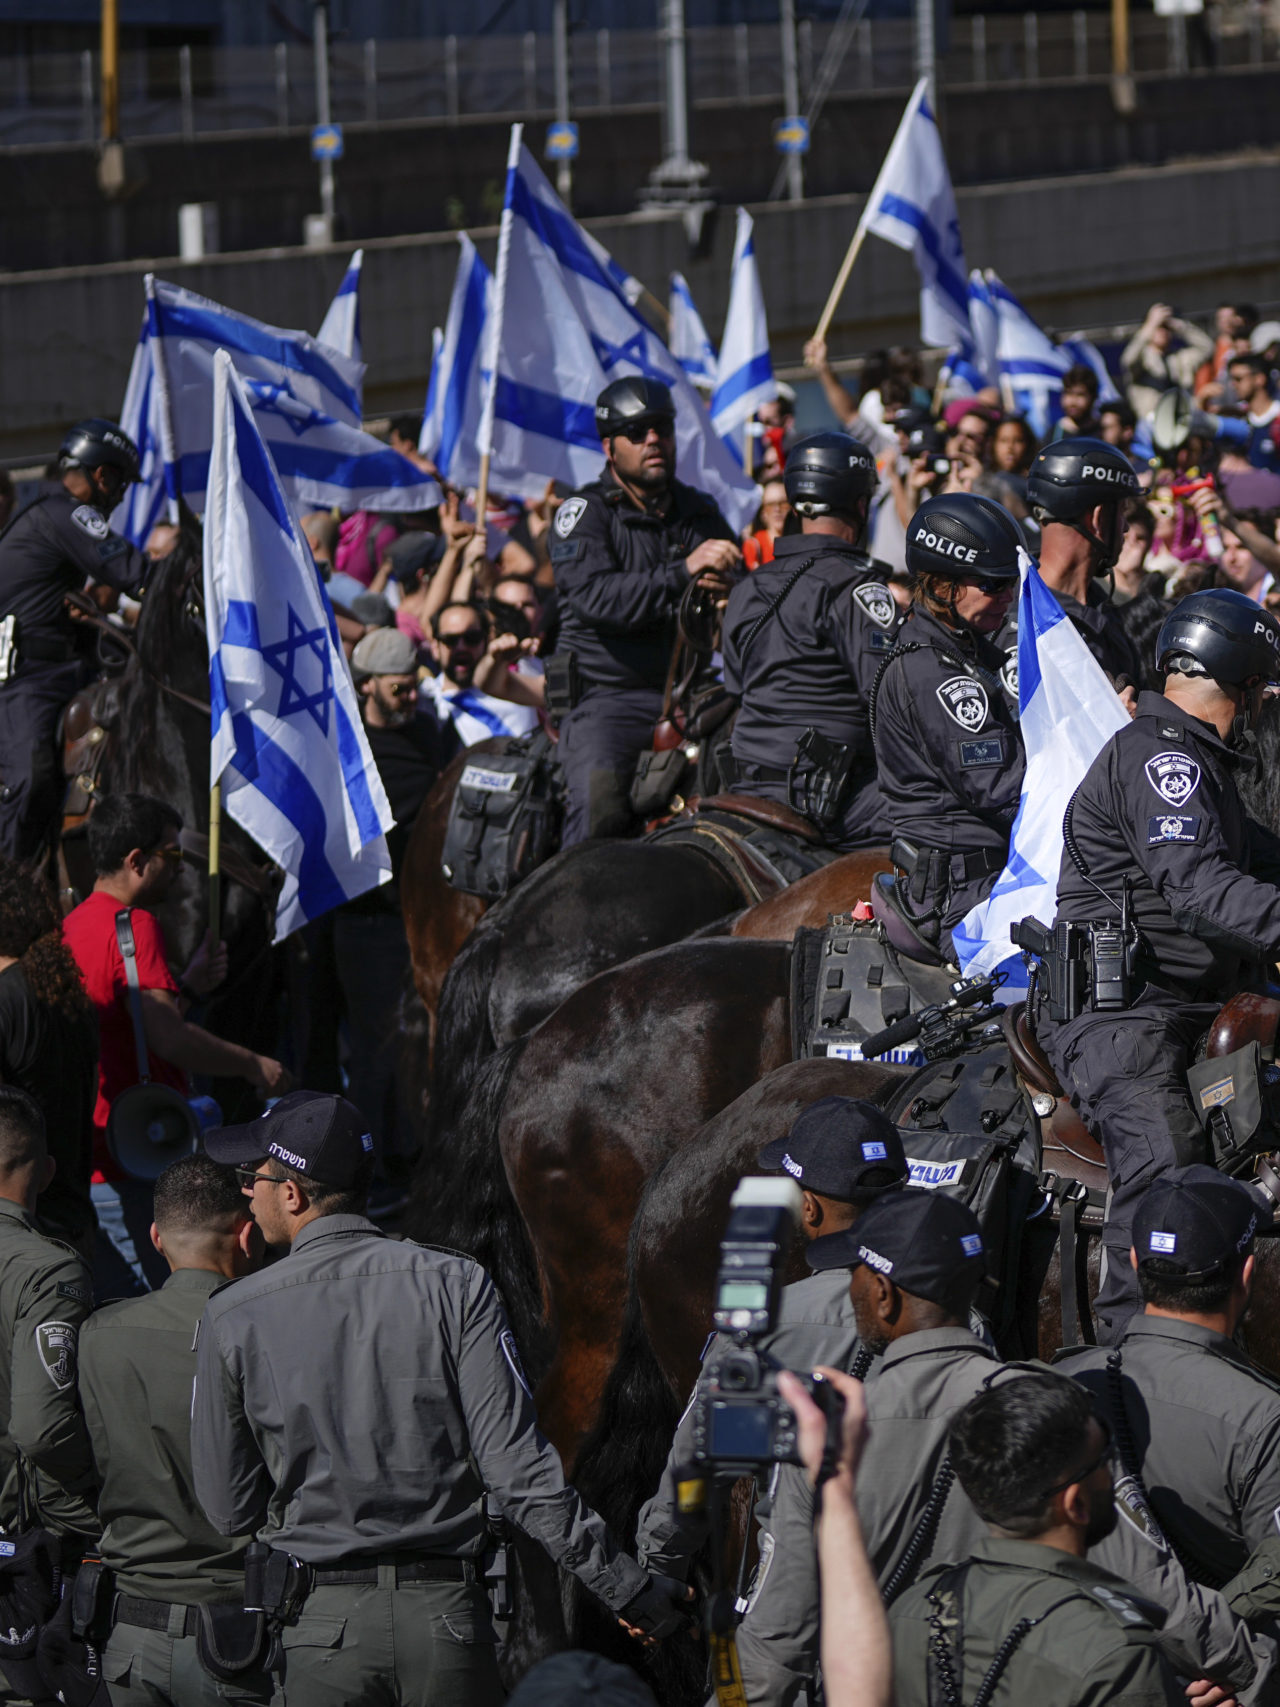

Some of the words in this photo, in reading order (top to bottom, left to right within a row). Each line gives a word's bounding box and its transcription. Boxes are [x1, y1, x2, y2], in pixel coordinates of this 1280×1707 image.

[1081, 465, 1134, 487] POLICE
[915, 528, 979, 563] POLICE
[269, 1142, 306, 1170] משטרה
